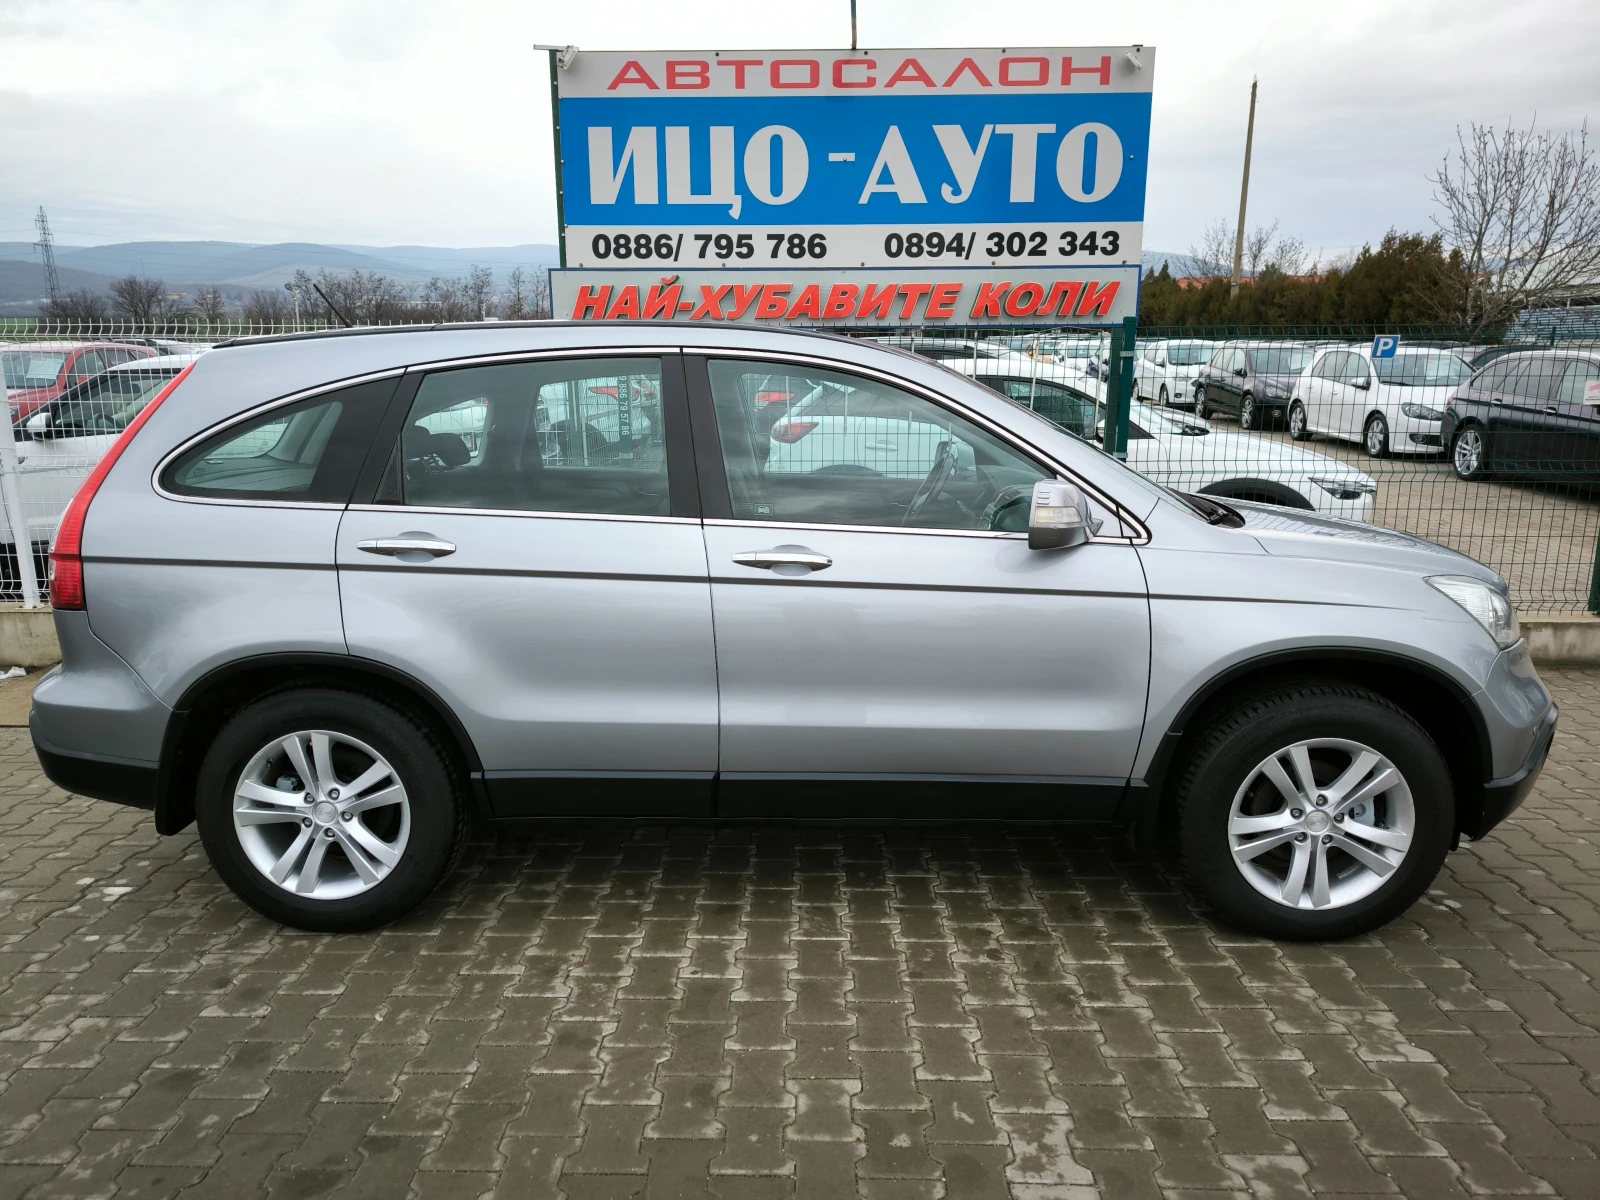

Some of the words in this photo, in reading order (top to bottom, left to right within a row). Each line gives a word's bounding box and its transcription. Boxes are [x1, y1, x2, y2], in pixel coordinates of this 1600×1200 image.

[607, 56, 1112, 90] АВТОСАЛОН
[592, 234, 683, 262] 0886/
[694, 234, 754, 259] 795
[766, 233, 827, 259] 786
[884, 232, 976, 260] 0894/
[985, 231, 1047, 257] 302
[1058, 230, 1120, 256] 343
[571, 275, 963, 319] НАЙ-ХУБАВИТЕ
[970, 281, 1121, 318] КОЛИ
[1376, 338, 1393, 356] P
